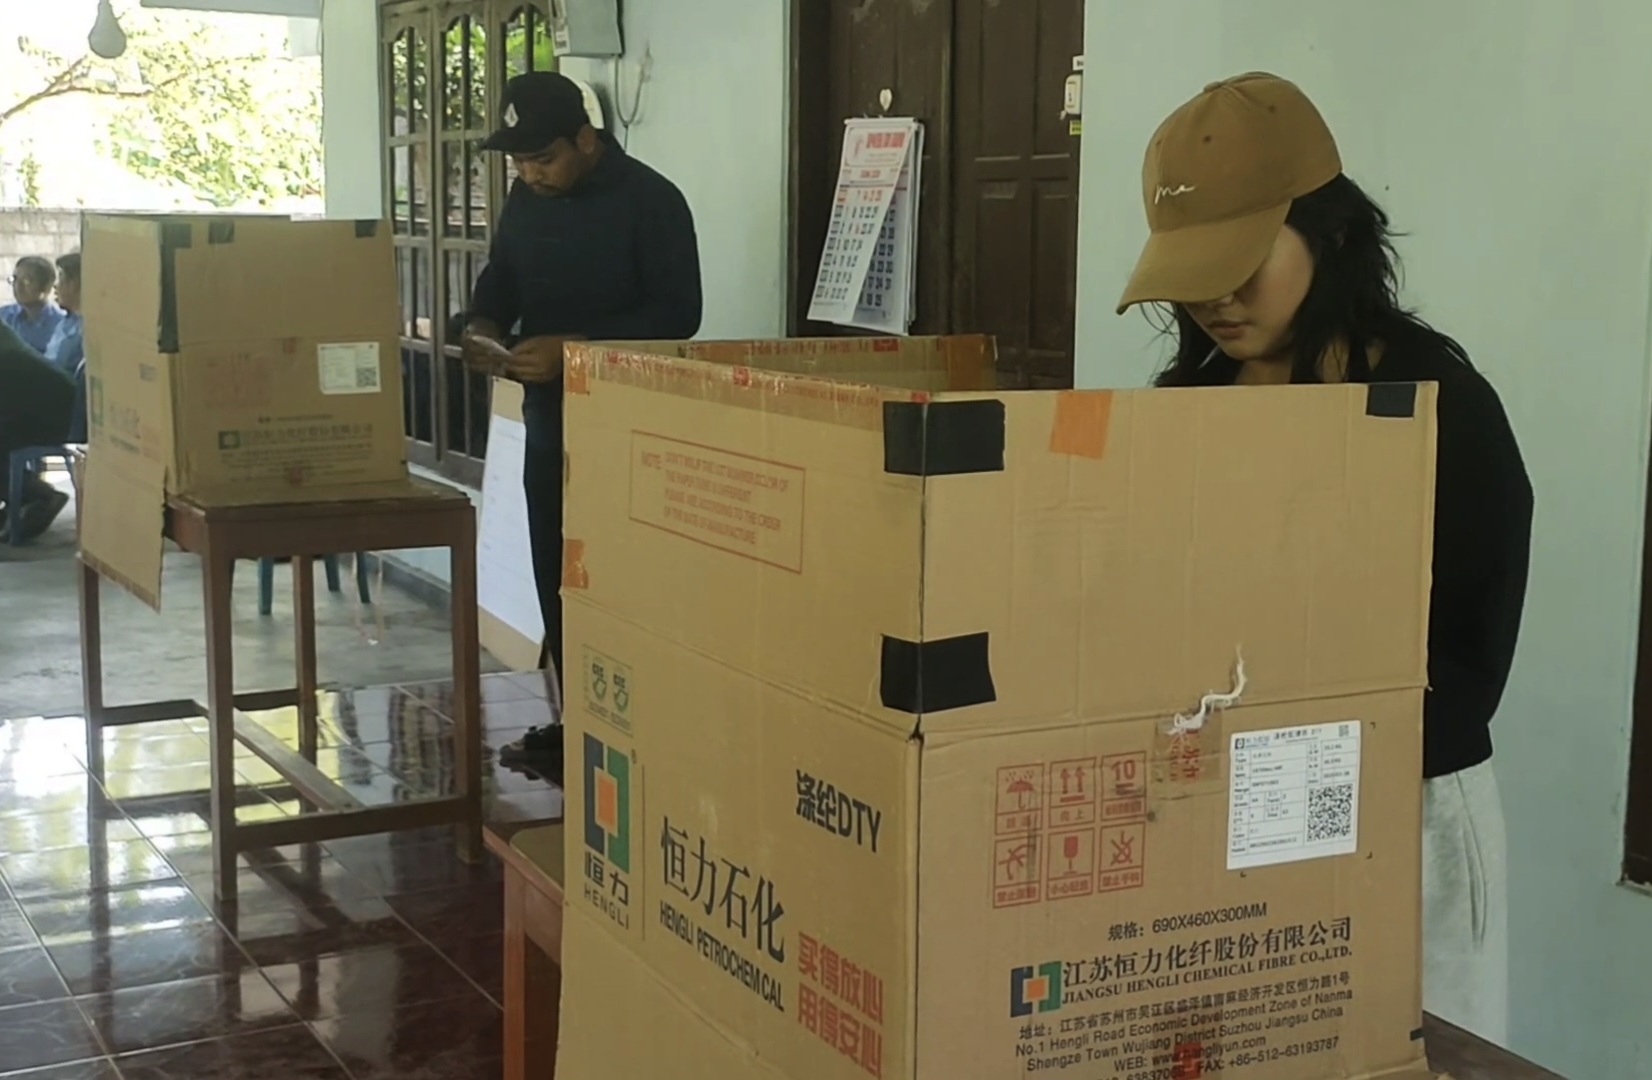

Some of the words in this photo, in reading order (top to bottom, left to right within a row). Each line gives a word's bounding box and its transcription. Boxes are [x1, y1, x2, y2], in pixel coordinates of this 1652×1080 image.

[1111, 759, 1136, 781] 10
[584, 850, 629, 907] 恒力
[660, 815, 785, 964] 恒力石化
[584, 883, 629, 930] HENGLI
[660, 900, 694, 946] HENGLI
[1152, 902, 1267, 934] 690X460X300MM
[798, 931, 884, 1026] 买得放心
[1062, 916, 1352, 988] 江苏恒力化纤股份有限公司
[1062, 984, 1123, 1004] JIANGSU
[1127, 974, 1179, 994] HENGLI
[1183, 962, 1256, 983] CHEMICAL
[1258, 954, 1297, 971] FIBRE
[1016, 1041, 1045, 1057] No.1
[1050, 1033, 1090, 1051] Hengli
[1093, 1027, 1126, 1043] Road
[1129, 1016, 1187, 1037] Economic
[1191, 1003, 1266, 1026] Development
[1269, 999, 1299, 1013] Zone
[1301, 993, 1312, 1008] of
[1315, 988, 1353, 1004] Nanma
[1027, 1052, 1083, 1072] Shengze
[1087, 1046, 1119, 1061] Town
[1122, 1037, 1171, 1055] Wujiang
[1175, 1026, 1216, 1046] District
[1219, 1019, 1262, 1038] Suzhou
[1265, 1012, 1310, 1029] Jiangsu
[1312, 1005, 1344, 1021] China
[1114, 1055, 1148, 1072] WEB:
